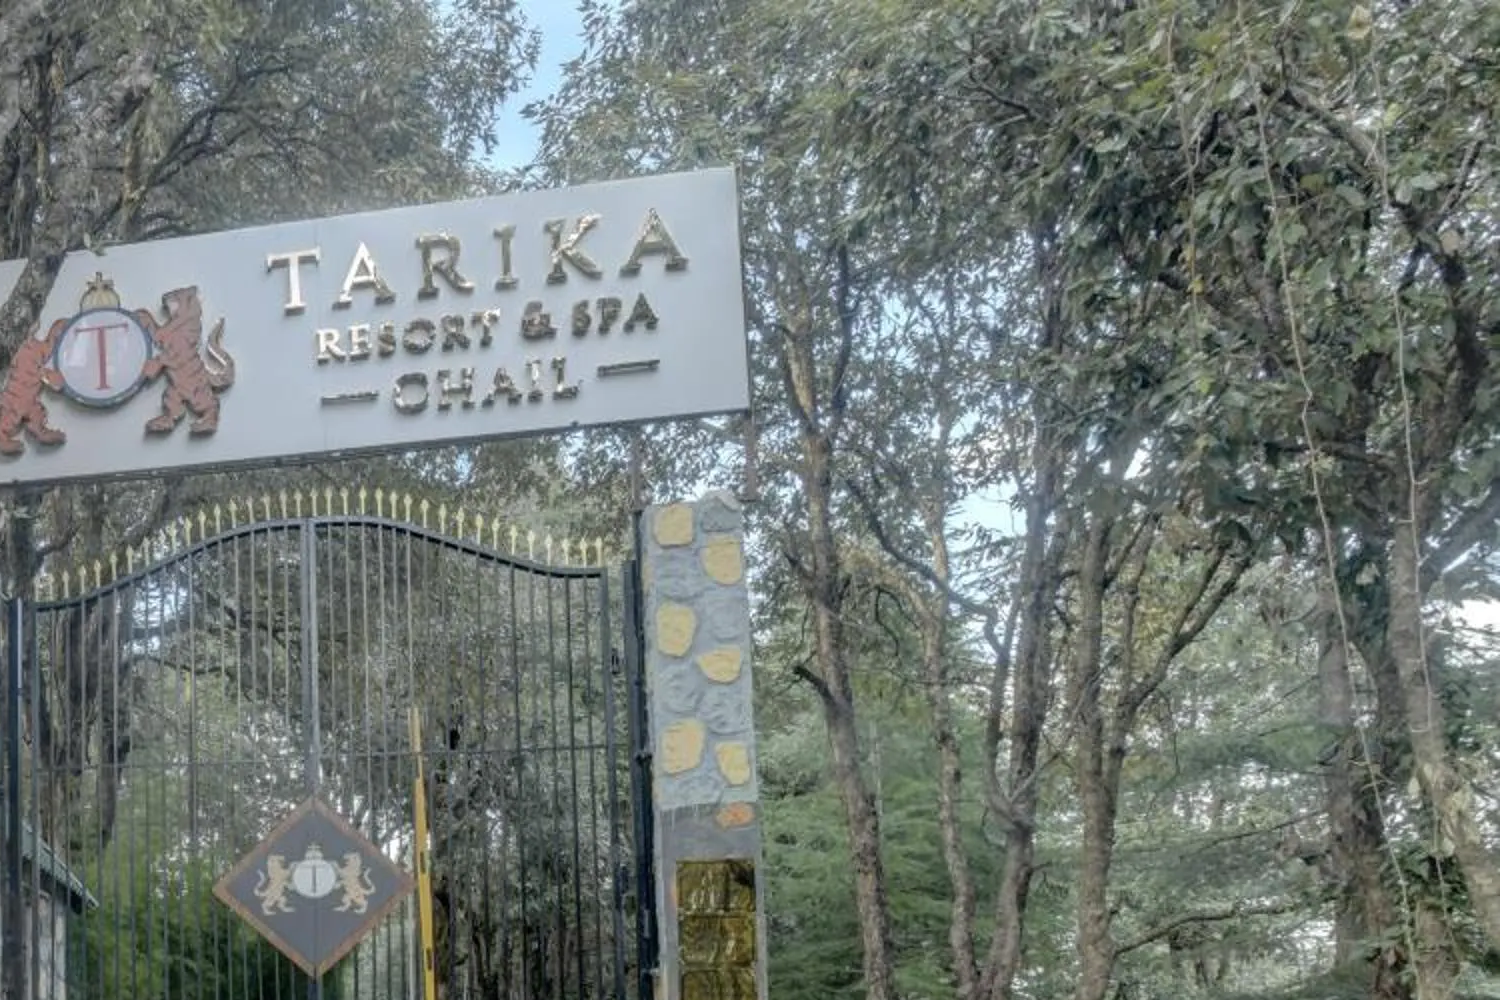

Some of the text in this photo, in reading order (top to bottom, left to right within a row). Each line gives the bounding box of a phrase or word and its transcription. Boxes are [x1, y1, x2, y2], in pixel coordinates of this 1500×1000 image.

[266, 207, 689, 315] TARIKA
[315, 292, 660, 366] RESORT & SPA
[393, 356, 583, 415] CHAIL
